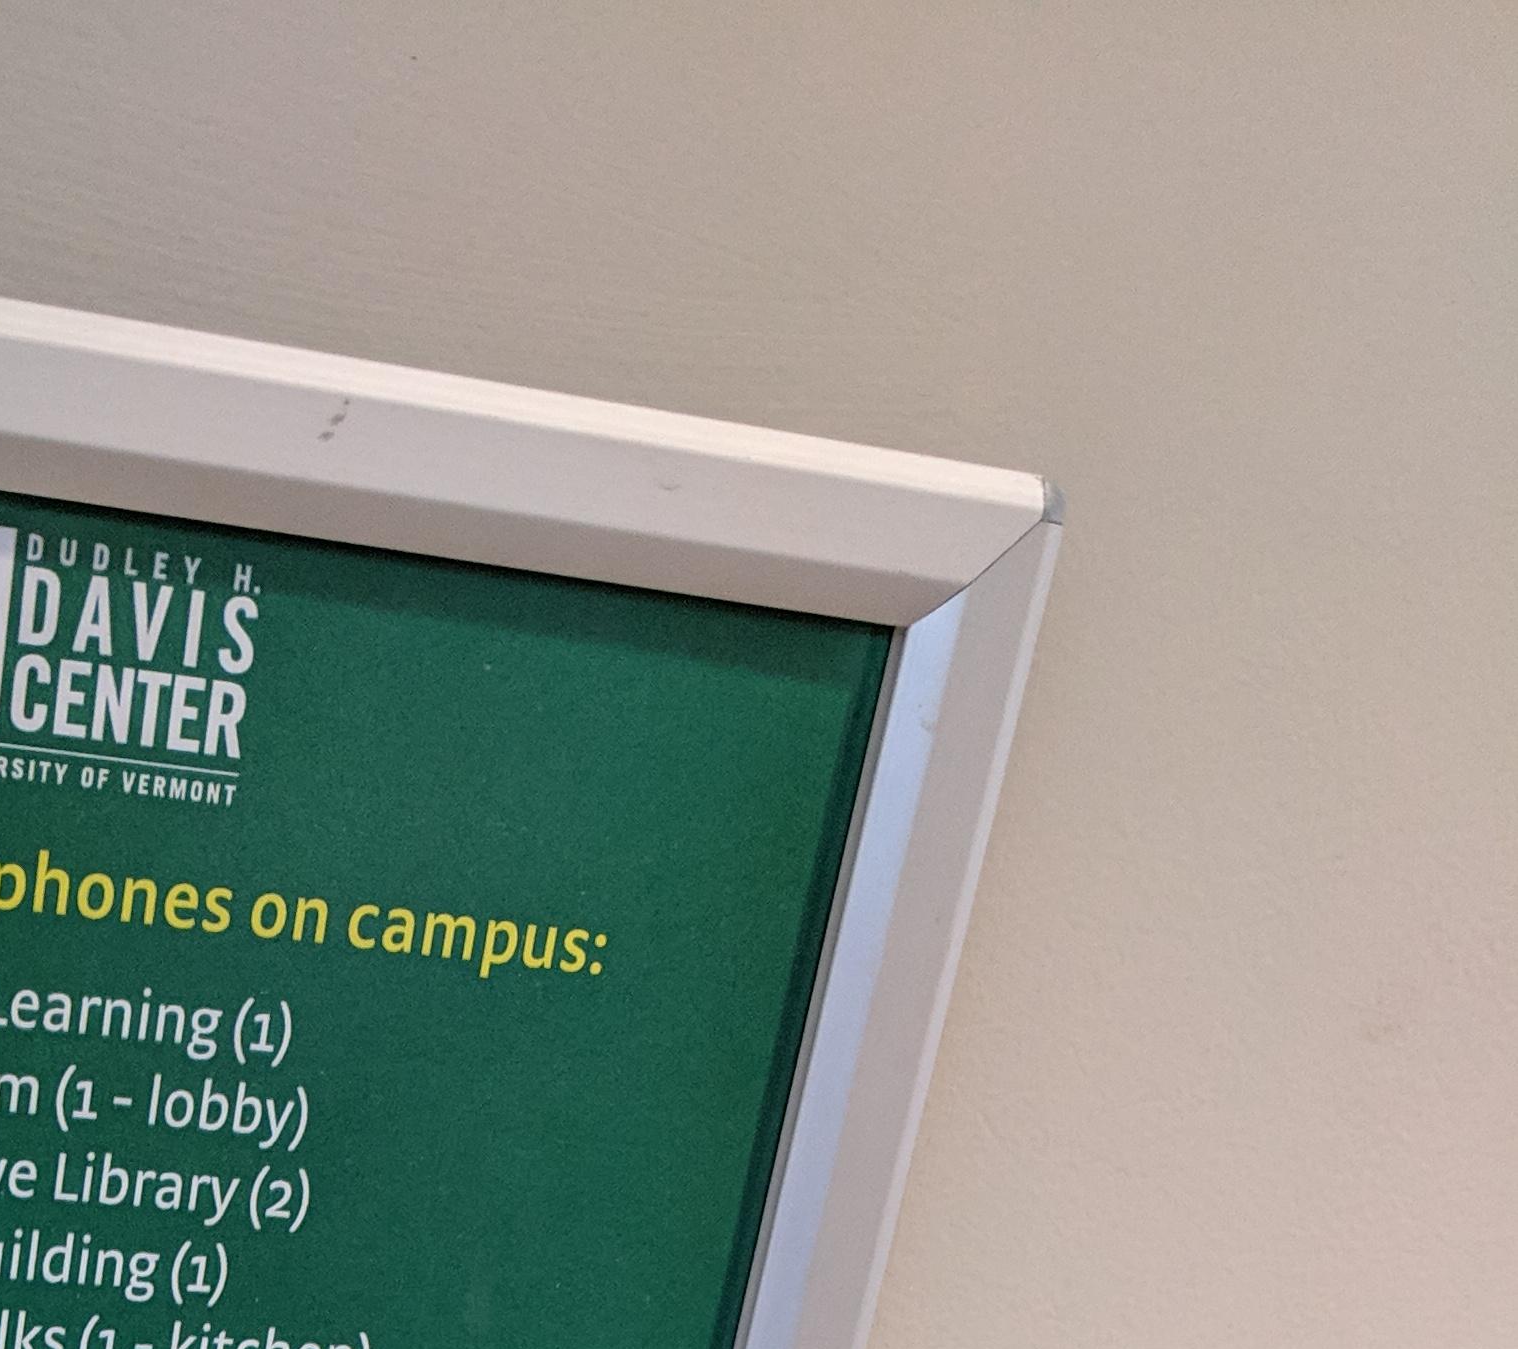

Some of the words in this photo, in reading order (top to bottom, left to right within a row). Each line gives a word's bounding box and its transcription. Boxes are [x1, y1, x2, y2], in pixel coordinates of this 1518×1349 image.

[27, 533, 201, 584] DUDLEY
[233, 564, 260, 594] H.
[17, 564, 260, 674] DAVIS
[10, 653, 247, 759] CENTER
[80, 766, 110, 789] OF
[122, 771, 237, 806] VERMONT
[250, 892, 329, 944] on
[347, 904, 607, 979] campus:
[233, 997, 292, 1068] (1)
[55, 1064, 98, 1132] (1
[148, 1073, 309, 1152] lobby)
[54, 1151, 241, 1227] Library
[249, 1165, 310, 1233] (2)
[171, 1240, 228, 1307] (1)
